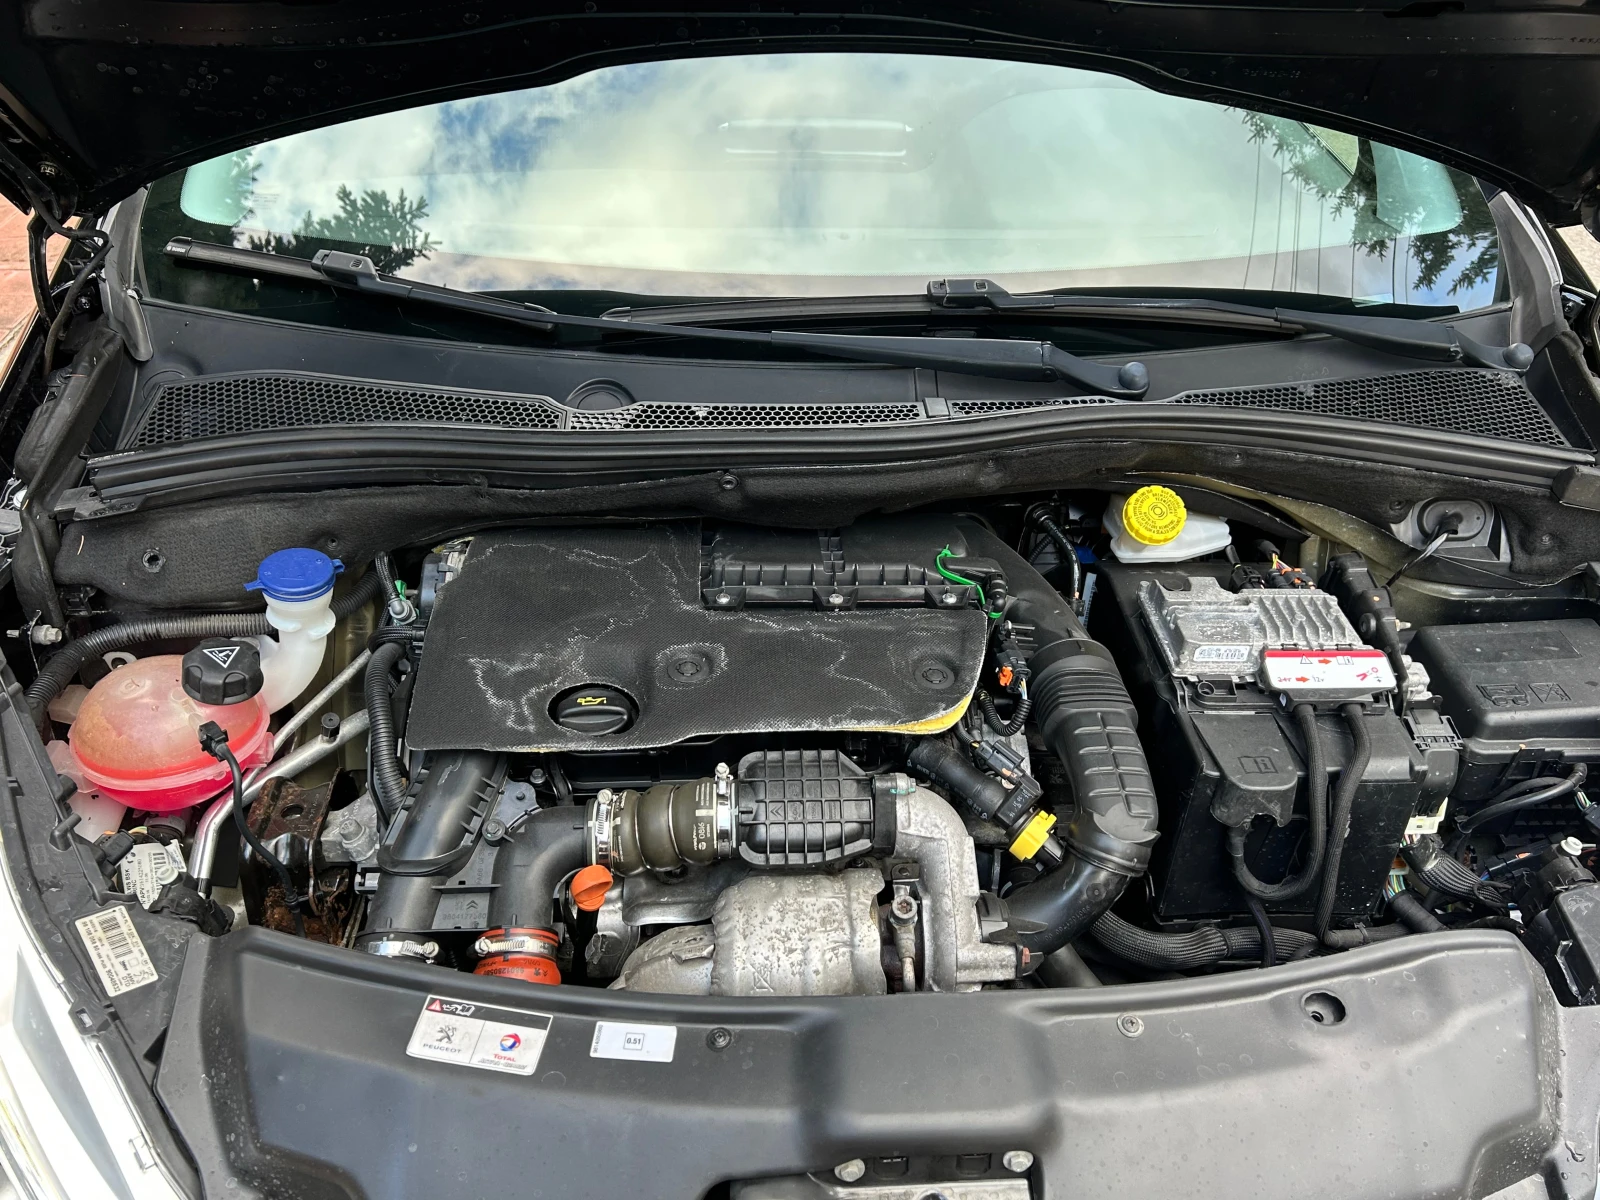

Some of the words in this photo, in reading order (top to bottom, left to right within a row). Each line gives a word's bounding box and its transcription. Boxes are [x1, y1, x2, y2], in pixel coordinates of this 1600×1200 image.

[627, 1036, 642, 1046] 0.51
[423, 1043, 462, 1054] PEUGEOT
[493, 1053, 517, 1063] TOTAL
